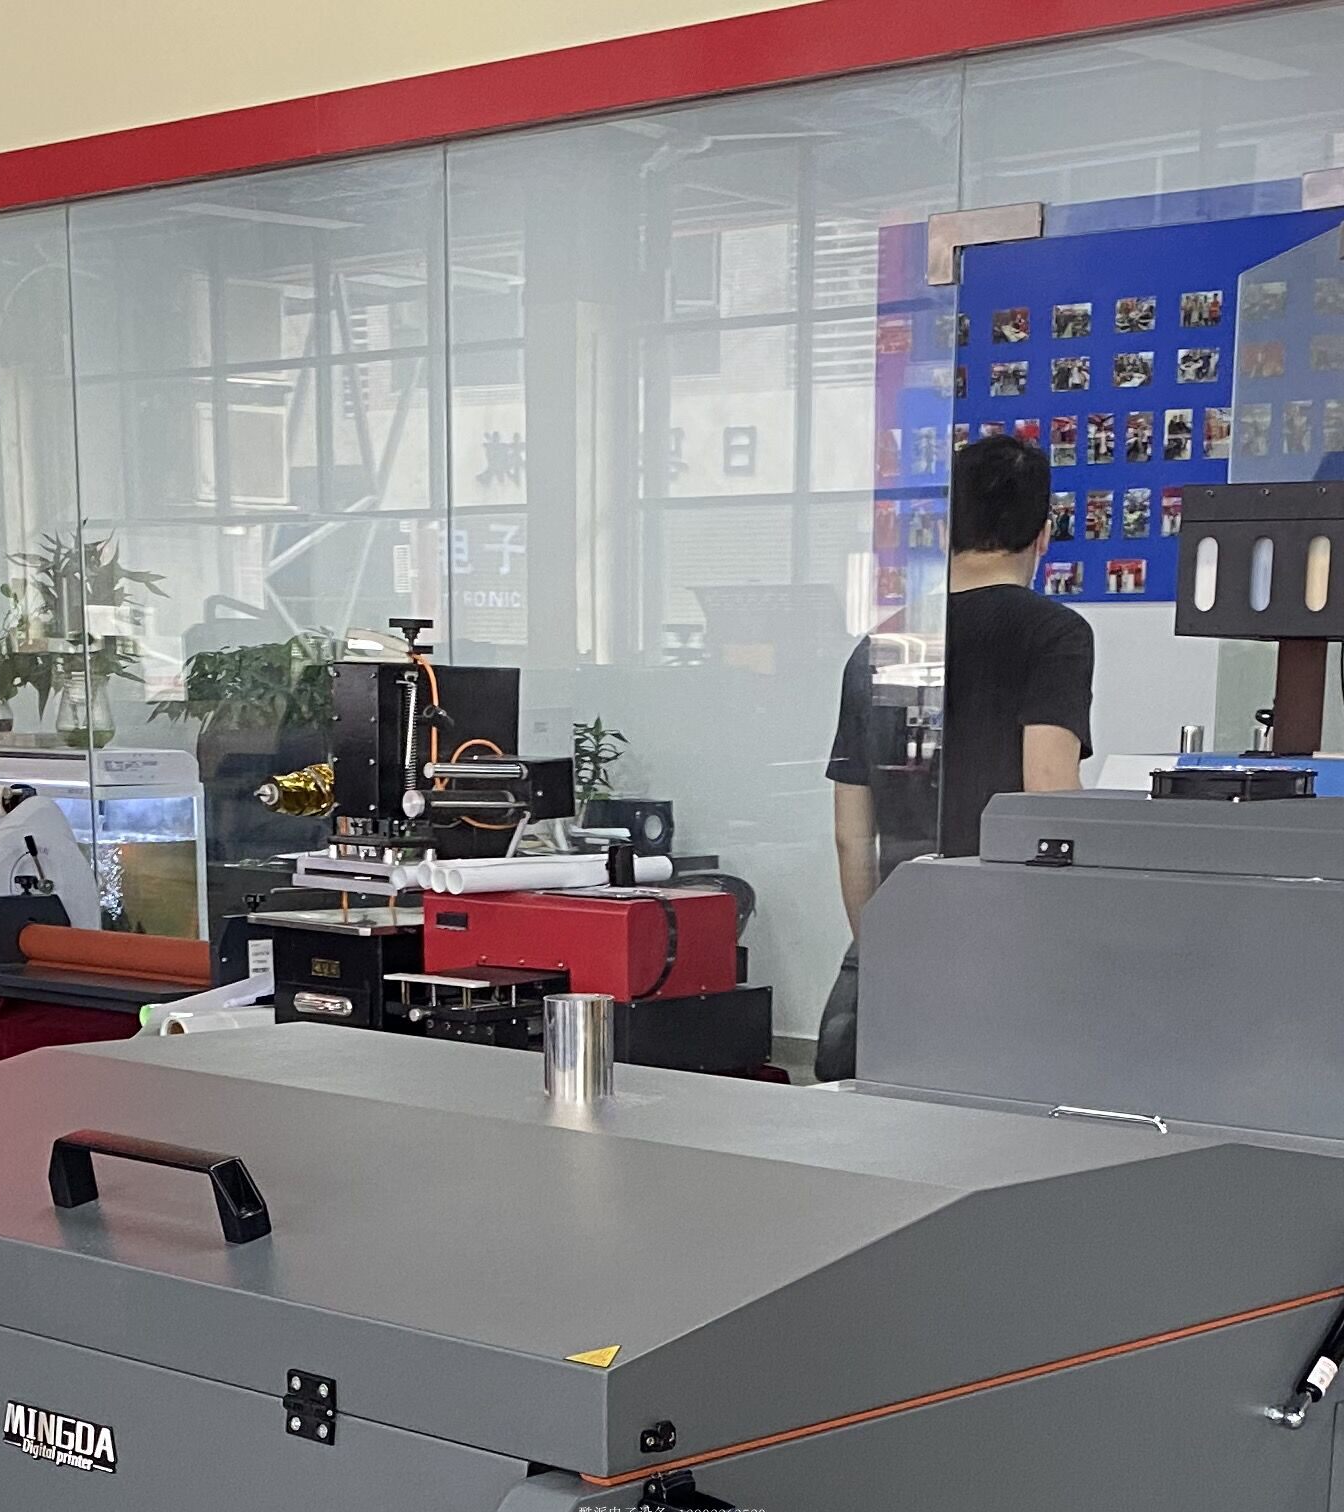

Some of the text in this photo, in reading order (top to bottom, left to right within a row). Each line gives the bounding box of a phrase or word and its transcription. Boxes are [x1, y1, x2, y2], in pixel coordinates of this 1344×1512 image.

[3, 1402, 116, 1464] MINGDA
[22, 1438, 94, 1472] Digital printer
